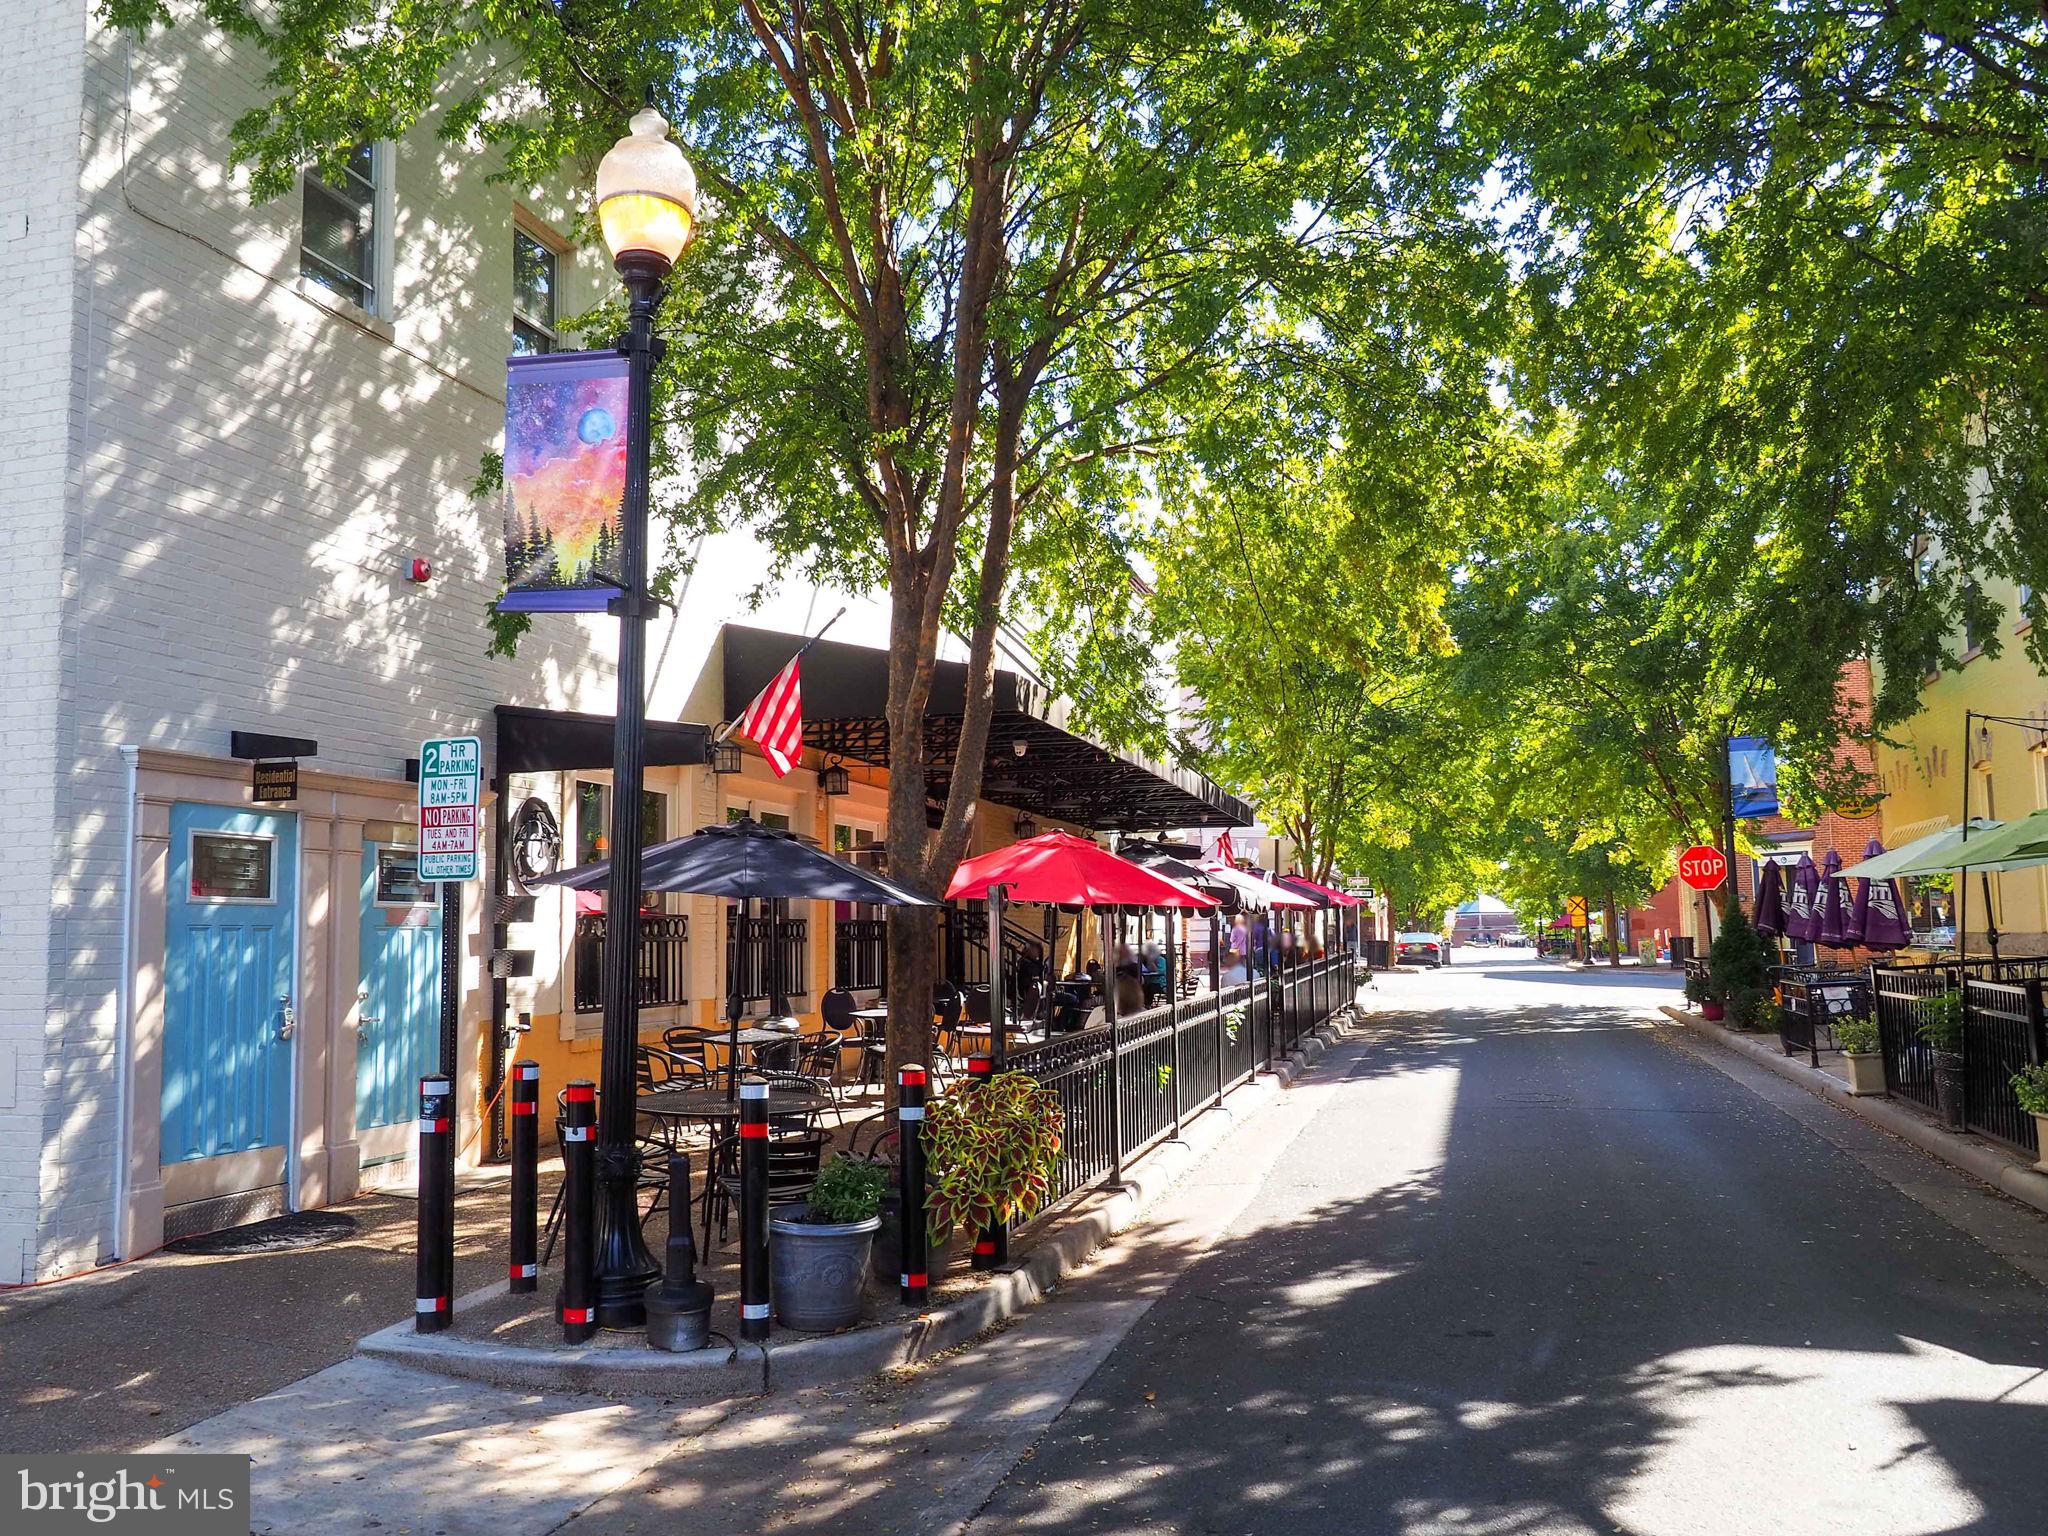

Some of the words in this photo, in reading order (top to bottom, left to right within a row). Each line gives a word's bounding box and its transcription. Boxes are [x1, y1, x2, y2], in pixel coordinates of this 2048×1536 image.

[425, 748, 437, 772] 2
[450, 745, 466, 757] HR
[440, 759, 475, 773] PARKING
[255, 769, 296, 784] Residential
[260, 786, 291, 799] Entrance
[430, 792, 468, 804] 8AM-5PM
[425, 808, 440, 826] NO
[442, 809, 471, 824] PARKING
[444, 828, 458, 838] AND
[431, 840, 465, 851] 4AM-7AM
[424, 854, 445, 864] PUBLIC
[446, 854, 471, 863] PARKING
[424, 865, 435, 875] ALL
[436, 865, 454, 874] OTHER
[455, 864, 472, 874] TIMES
[1682, 858, 1724, 877] STOP
